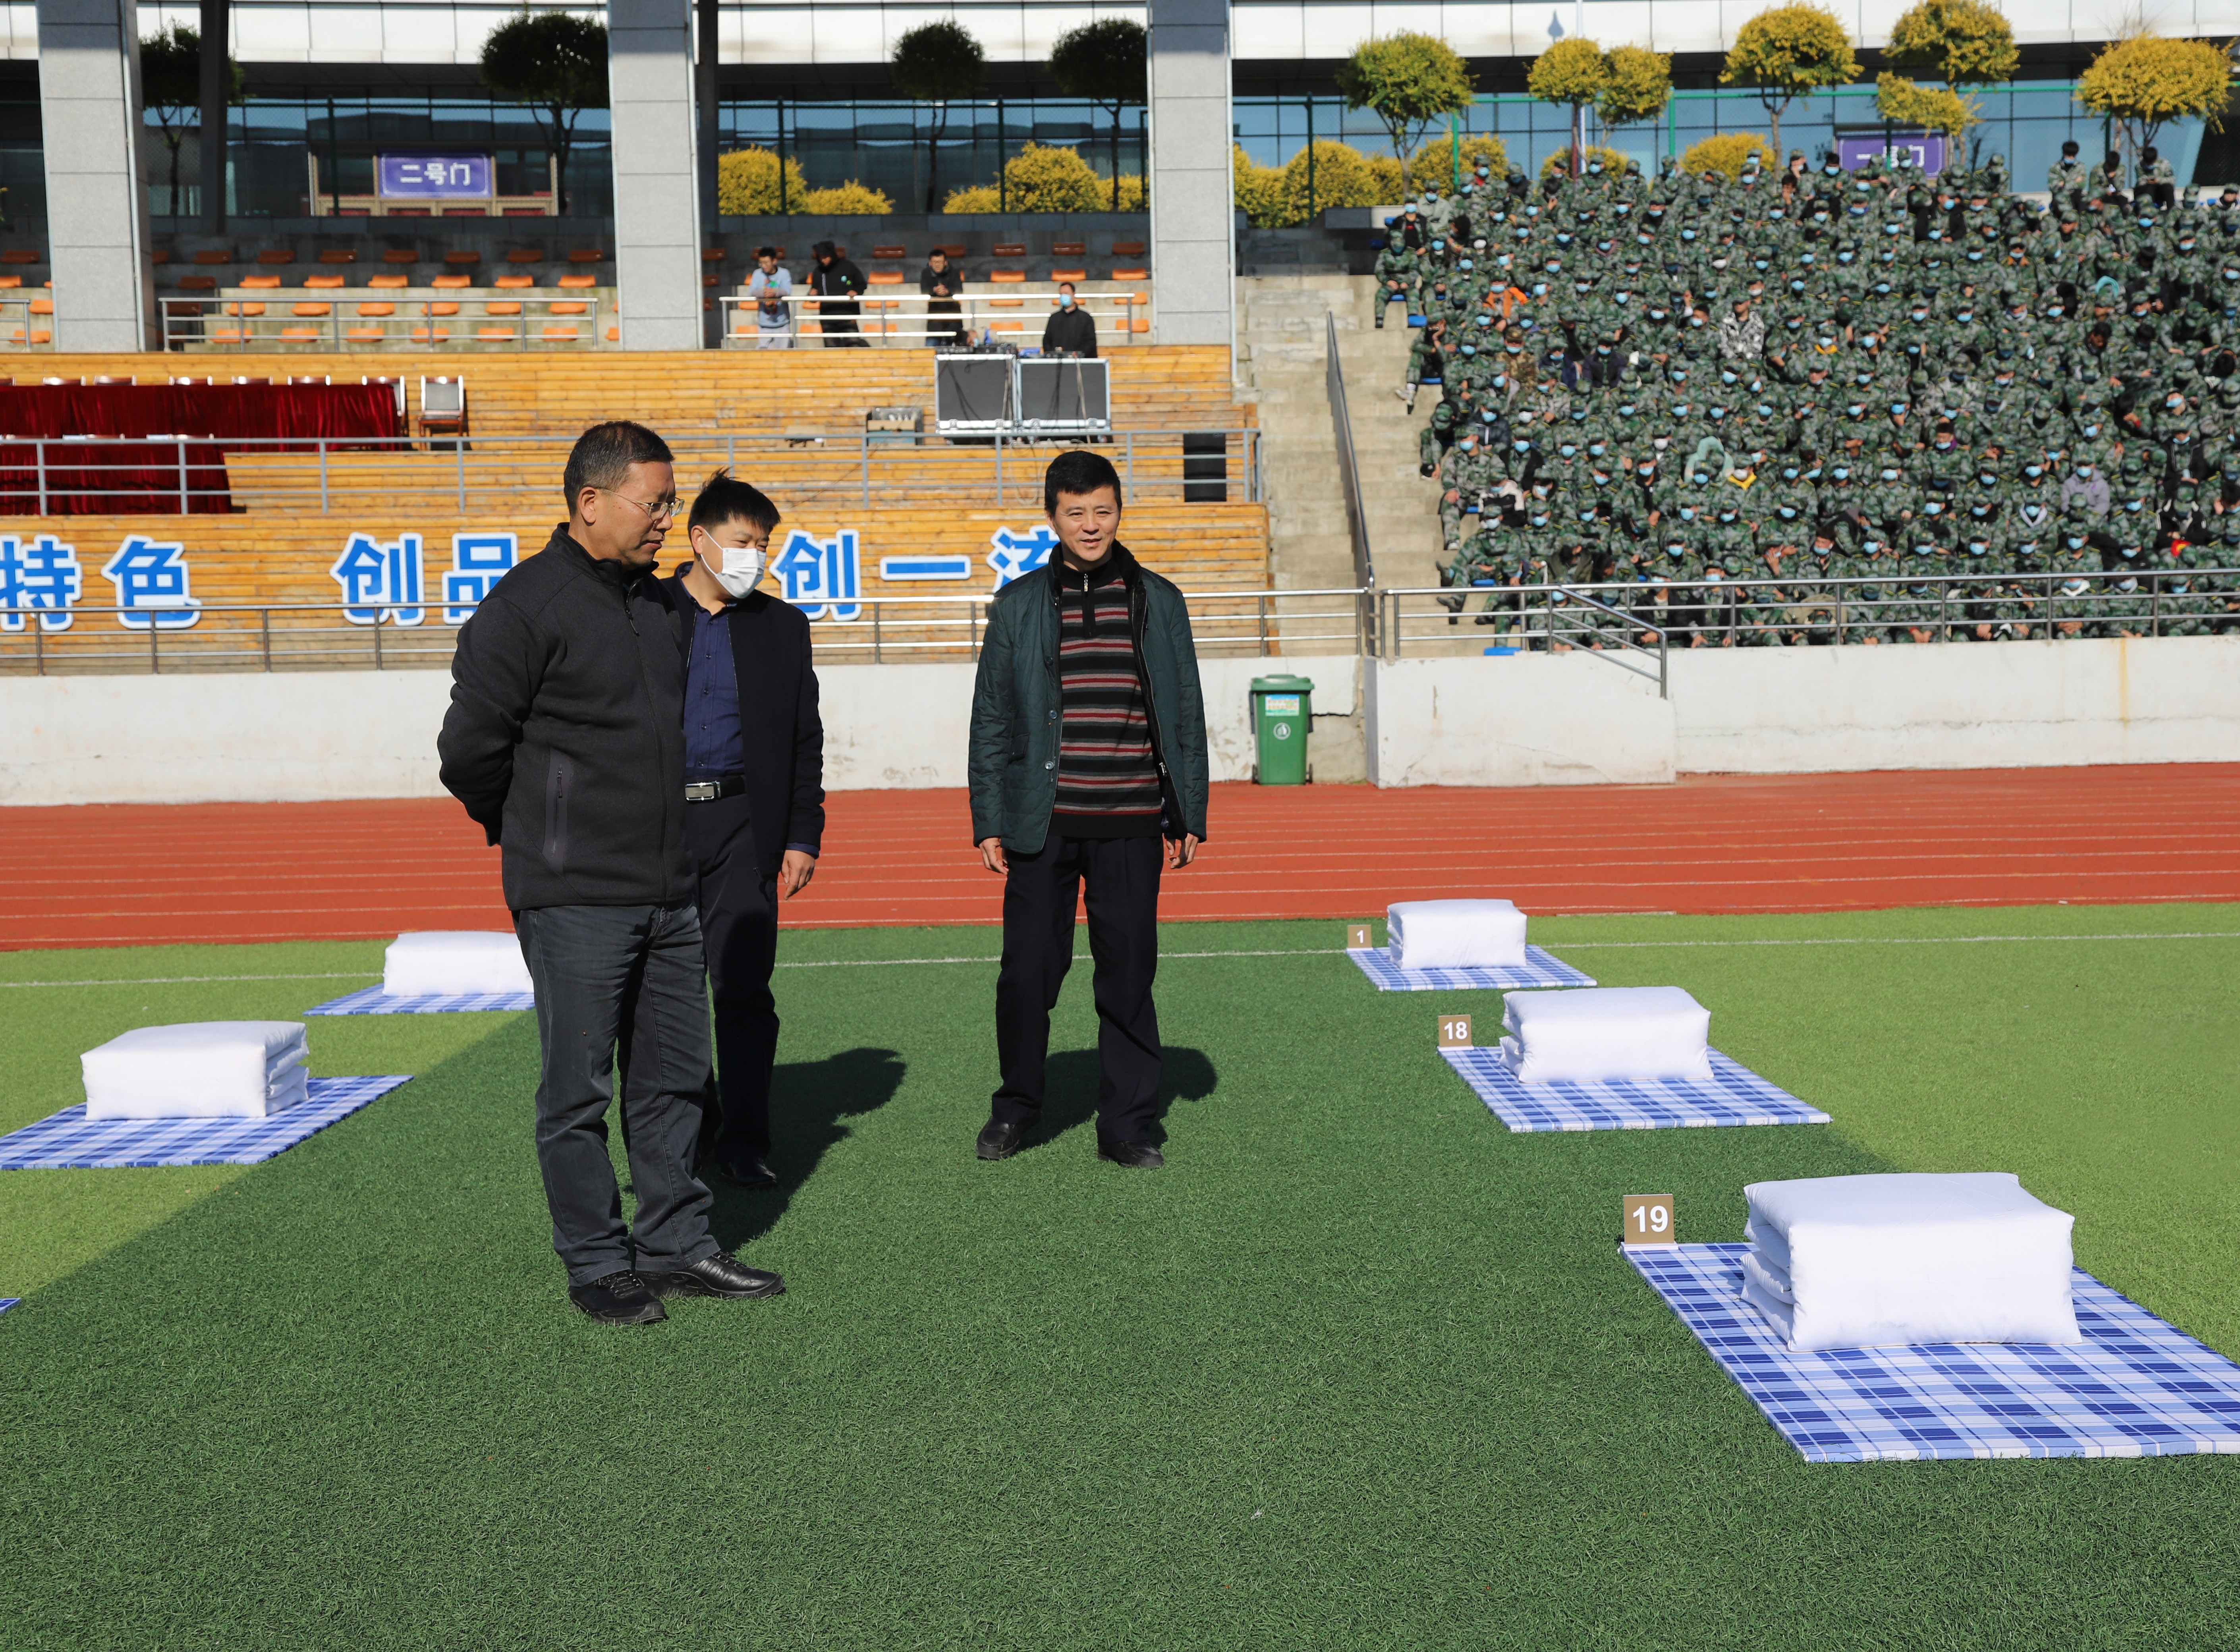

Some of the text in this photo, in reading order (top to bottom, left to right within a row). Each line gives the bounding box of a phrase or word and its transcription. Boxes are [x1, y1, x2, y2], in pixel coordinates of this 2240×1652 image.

[400, 162, 471, 186] 二号门
[0, 534, 202, 631] 特色
[1356, 930, 1363, 944] 1
[1444, 1021, 1468, 1040] 18
[1633, 1205, 1668, 1233] 19
